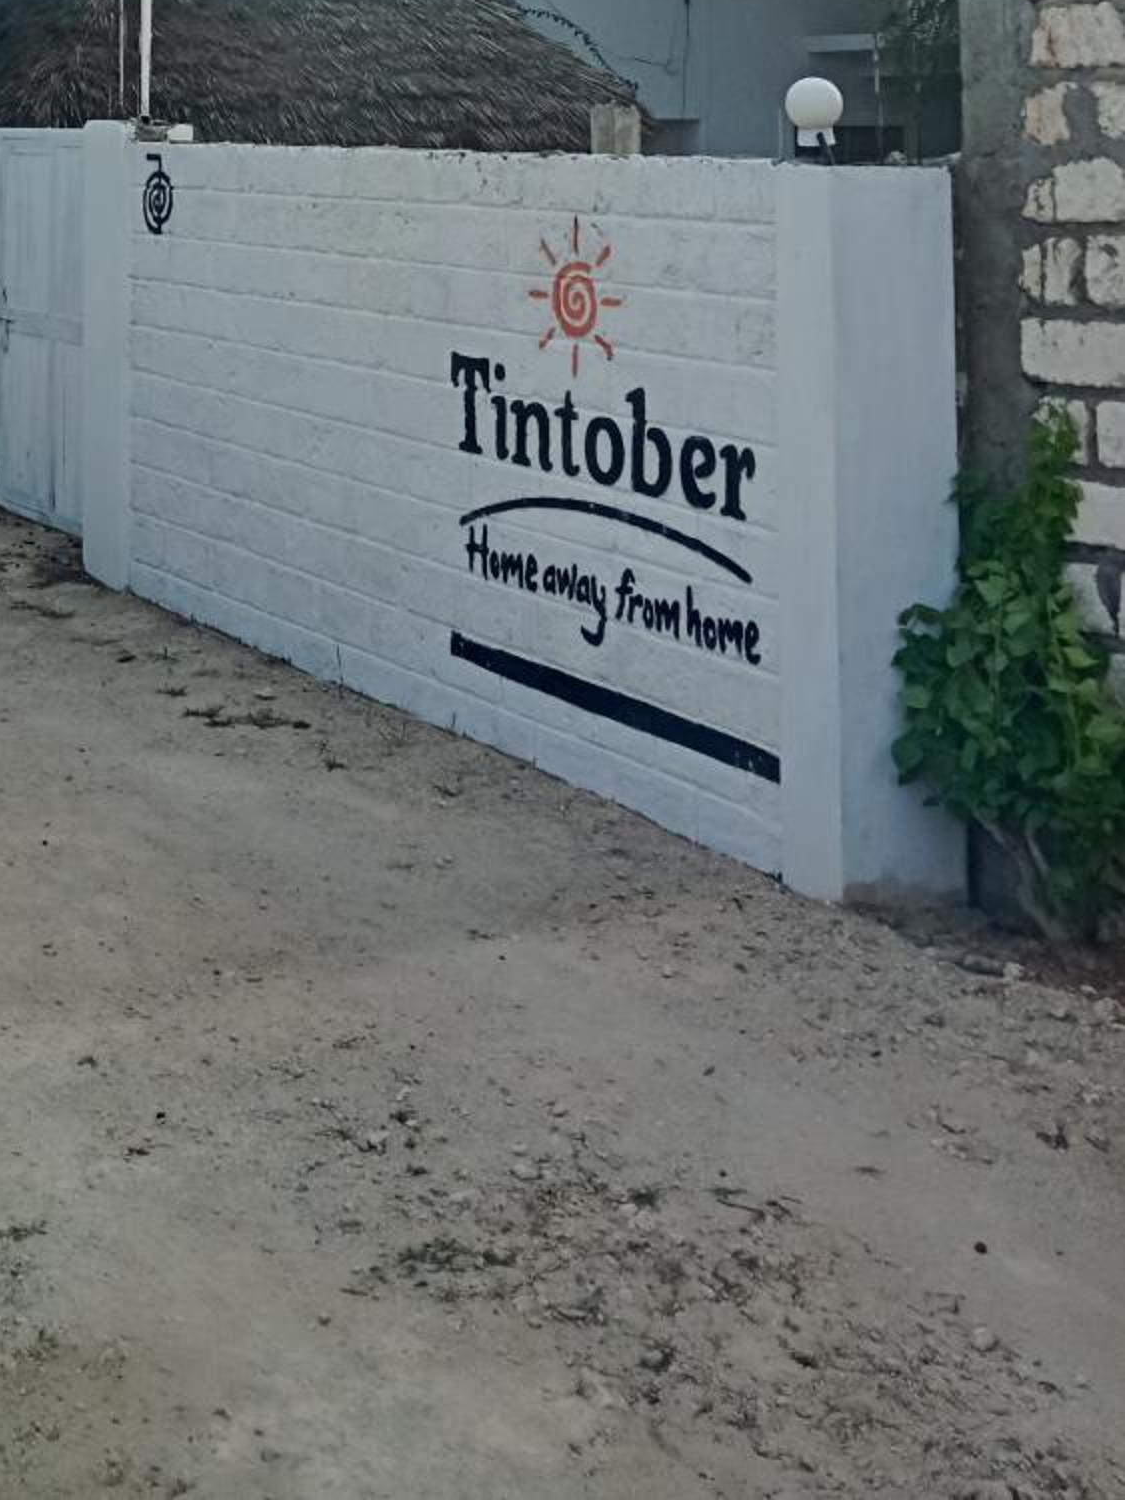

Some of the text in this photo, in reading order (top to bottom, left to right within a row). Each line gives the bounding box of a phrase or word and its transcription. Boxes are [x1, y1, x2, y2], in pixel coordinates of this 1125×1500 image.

[450, 351, 755, 521] Tintober
[465, 525, 761, 665] Home away from home
